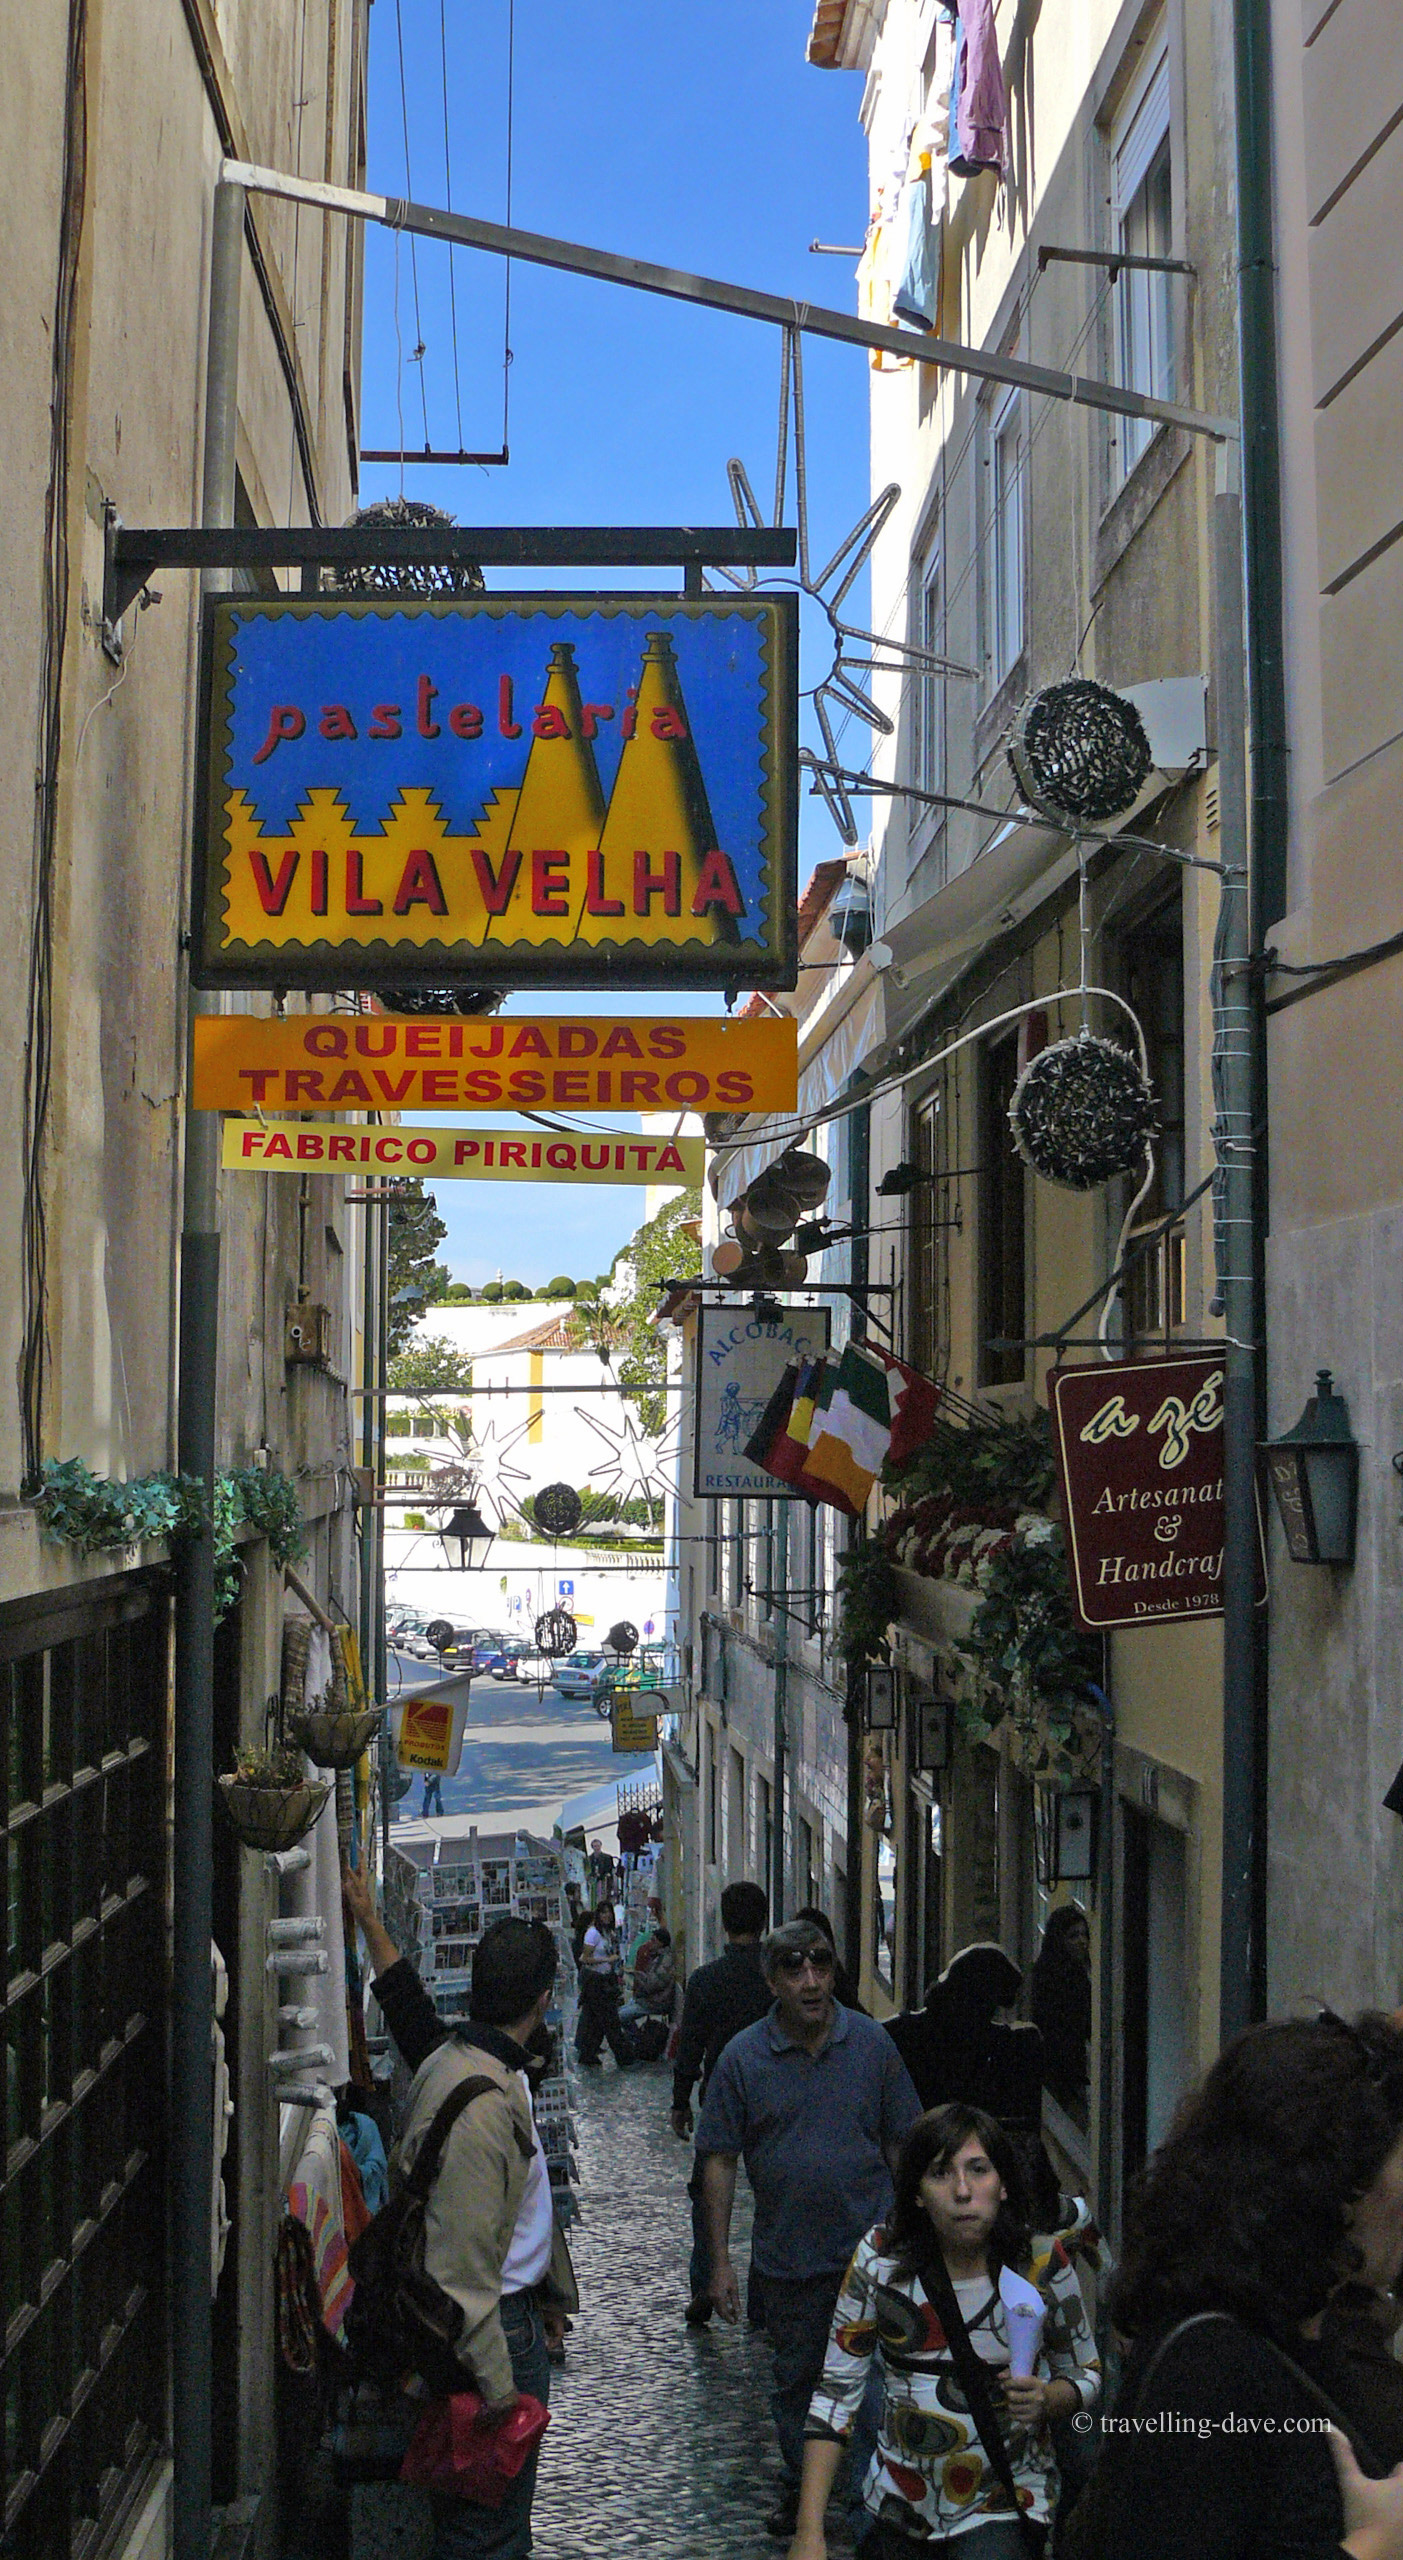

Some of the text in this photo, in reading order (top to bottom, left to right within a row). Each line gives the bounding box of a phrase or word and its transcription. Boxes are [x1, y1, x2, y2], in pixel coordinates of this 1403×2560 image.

[253, 675, 690, 763] pastelaria
[248, 850, 747, 917] VILA VELHA
[303, 1025, 687, 1059] QUEIJADAS
[239, 1069, 754, 1104] TRAVESSEIROS
[241, 1131, 437, 1165] FABRICO
[709, 1321, 812, 1367] ALCOBAC
[1080, 1395, 1140, 1444] a
[1091, 1477, 1224, 1515] Artesanat
[1153, 1514, 1182, 1542] &
[1095, 1546, 1225, 1586] Handcraf
[1133, 1593, 1219, 1614] Desde 1978
[410, 1754, 443, 1767] Kodak
